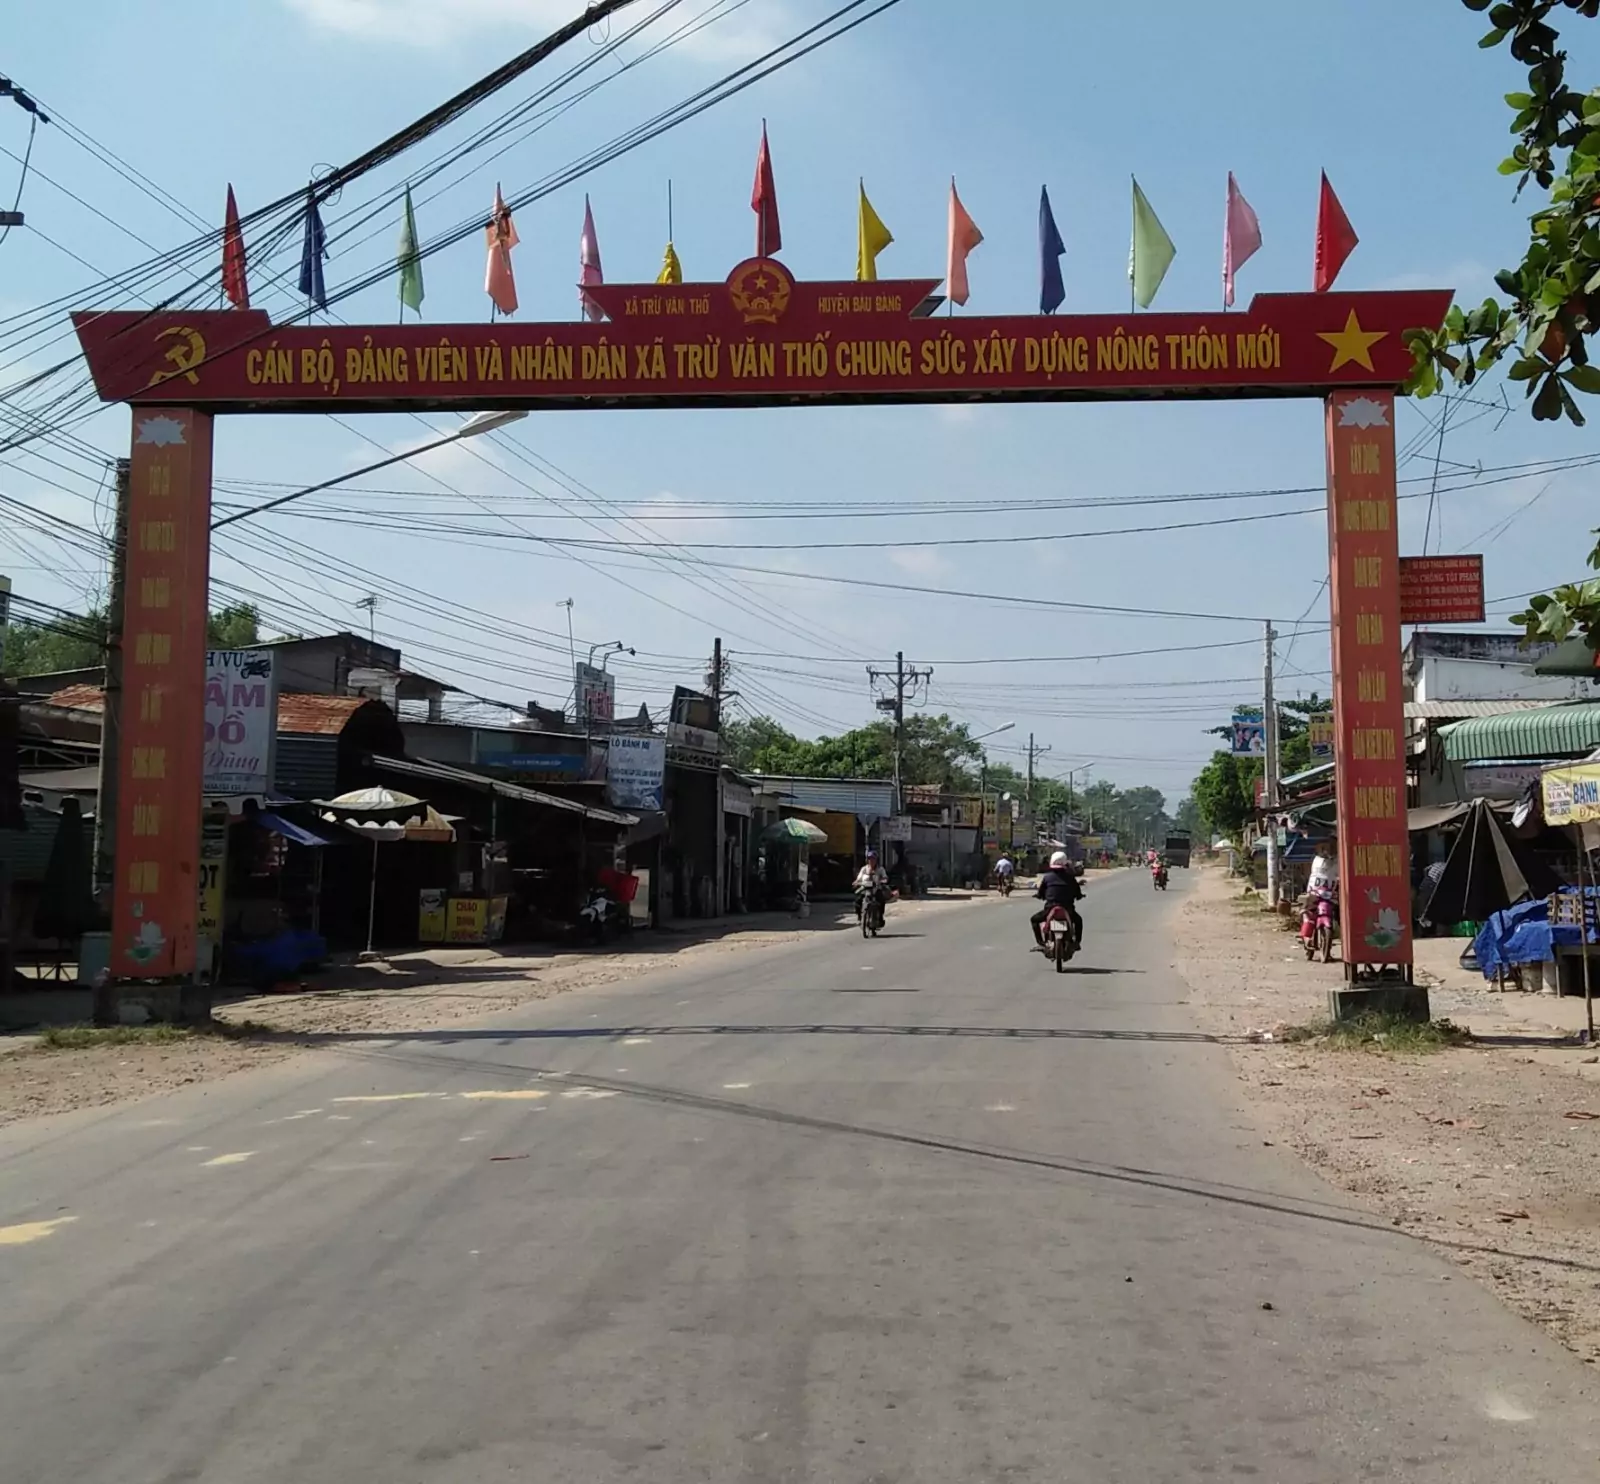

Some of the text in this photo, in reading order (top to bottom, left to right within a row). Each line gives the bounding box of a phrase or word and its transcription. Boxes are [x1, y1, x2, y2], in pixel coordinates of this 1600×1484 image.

[246, 323, 1281, 395] CÁN BỘ, ĐẢNG VIÊN VÀ NHÂN DÂN XÃ TRỪ VĂN THỐ CHUNG SỨC XÂY DỰNG NÔNG THÔN MỚI
[1572, 775, 1599, 805] BÁNH
